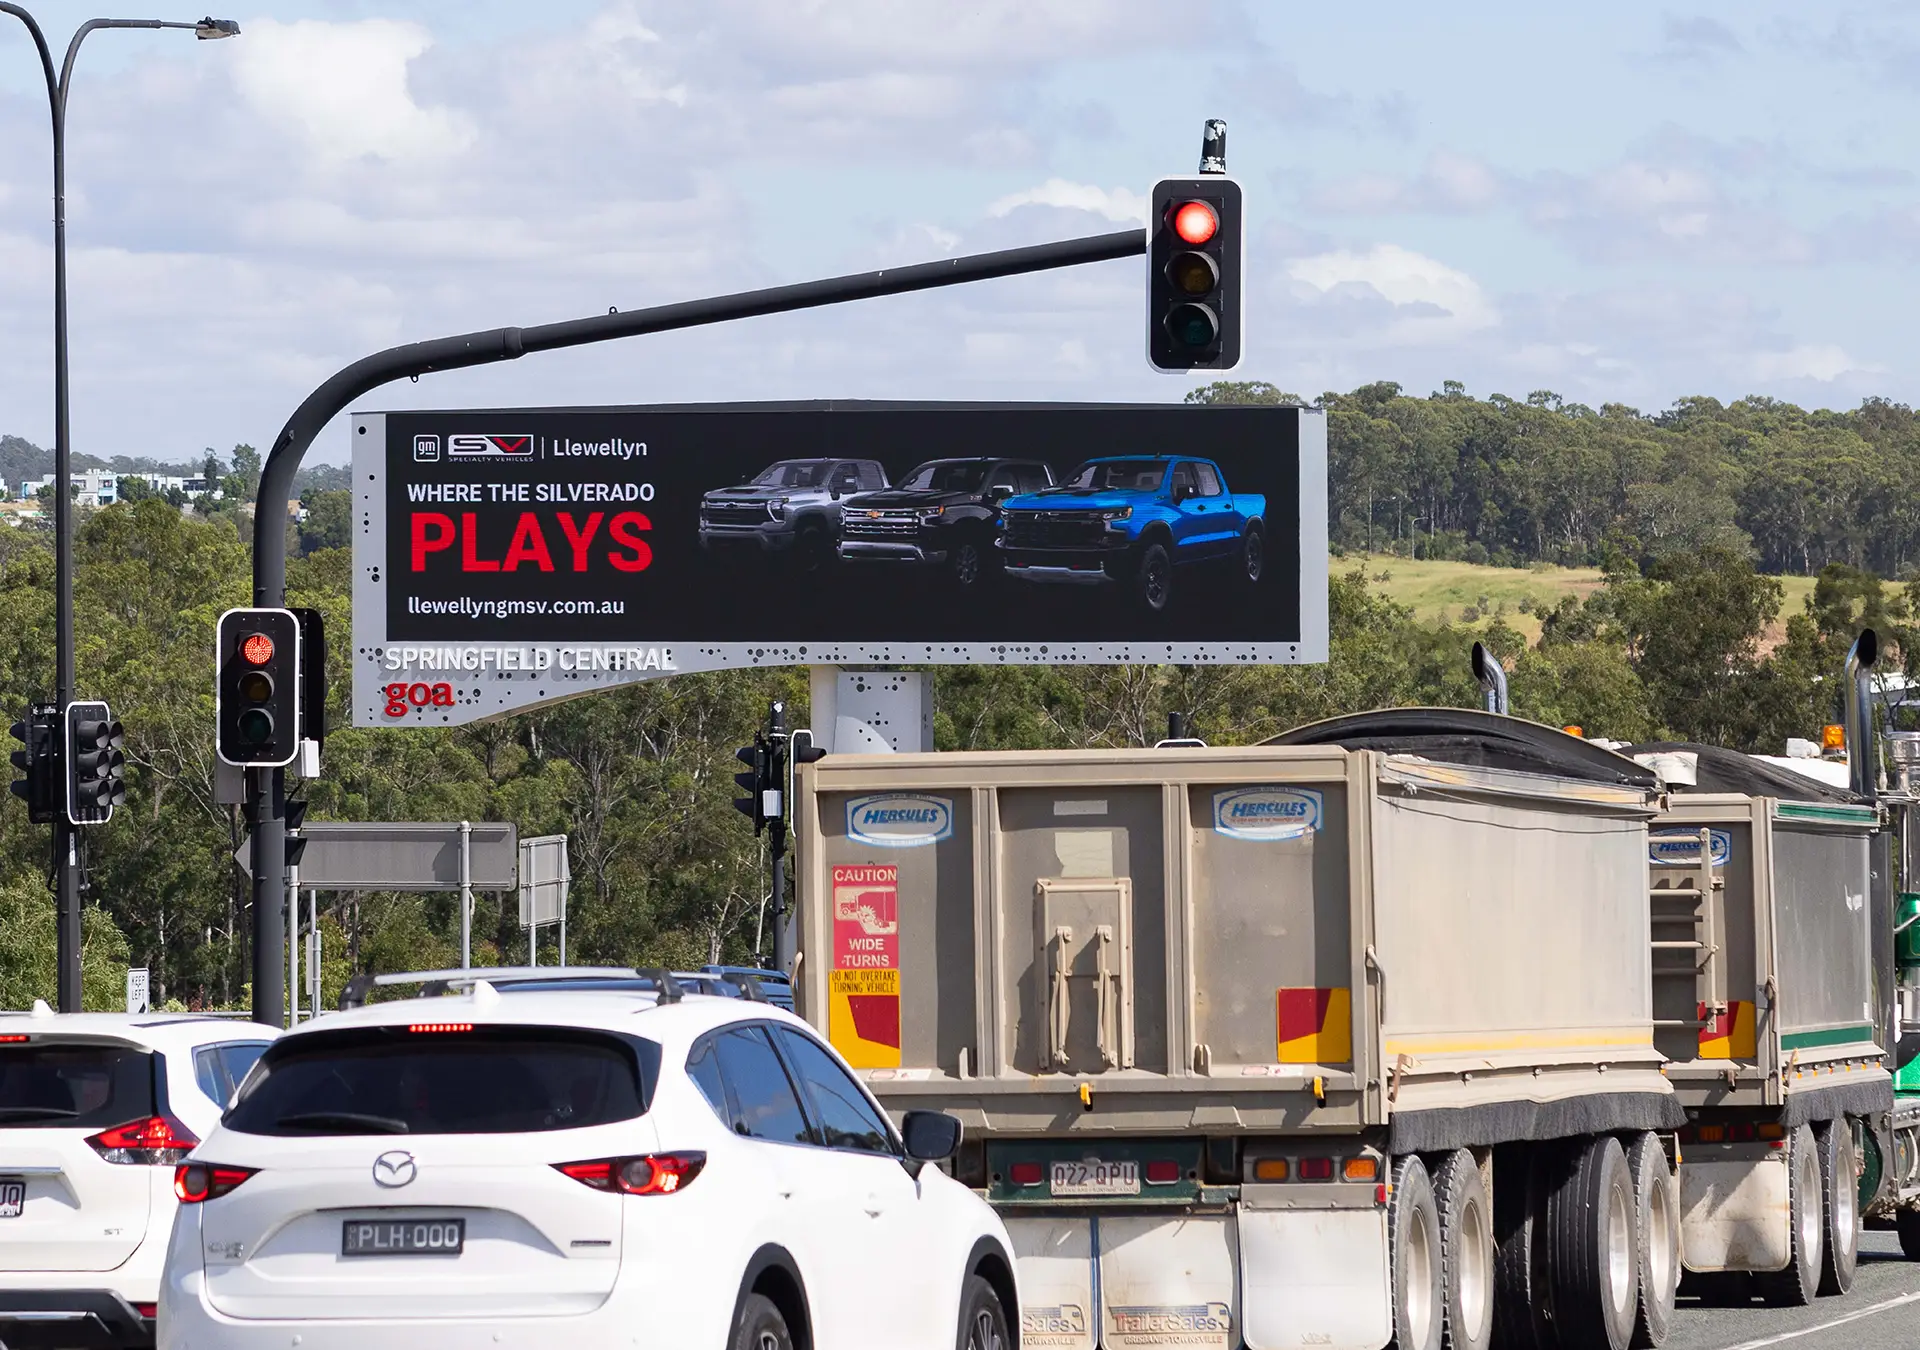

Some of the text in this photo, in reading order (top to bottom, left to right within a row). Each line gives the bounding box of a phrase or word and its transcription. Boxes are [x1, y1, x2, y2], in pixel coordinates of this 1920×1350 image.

[418, 441, 435, 455] gm
[553, 438, 647, 460] Llewellyn
[407, 483, 655, 502] WHERE THE SILVERADO
[411, 512, 653, 572] PLAYS
[408, 597, 625, 618] llewellyngmsv.com.au
[384, 647, 677, 671] SPRINGFIELD CENTRAL
[384, 681, 456, 717] goa
[863, 808, 938, 824] HERCULES
[1231, 802, 1307, 817] HERCULES
[1658, 840, 1720, 852] HERCUS
[834, 869, 897, 882] CAUTION
[849, 938, 884, 951] WIDE
[843, 954, 890, 967] TURNS
[131, 974, 145, 987] KEEP
[832, 970, 896, 981] DO NOT OVERTAKE
[131, 988, 145, 1001] LEFT
[834, 982, 894, 993] TURNING VEHICLE
